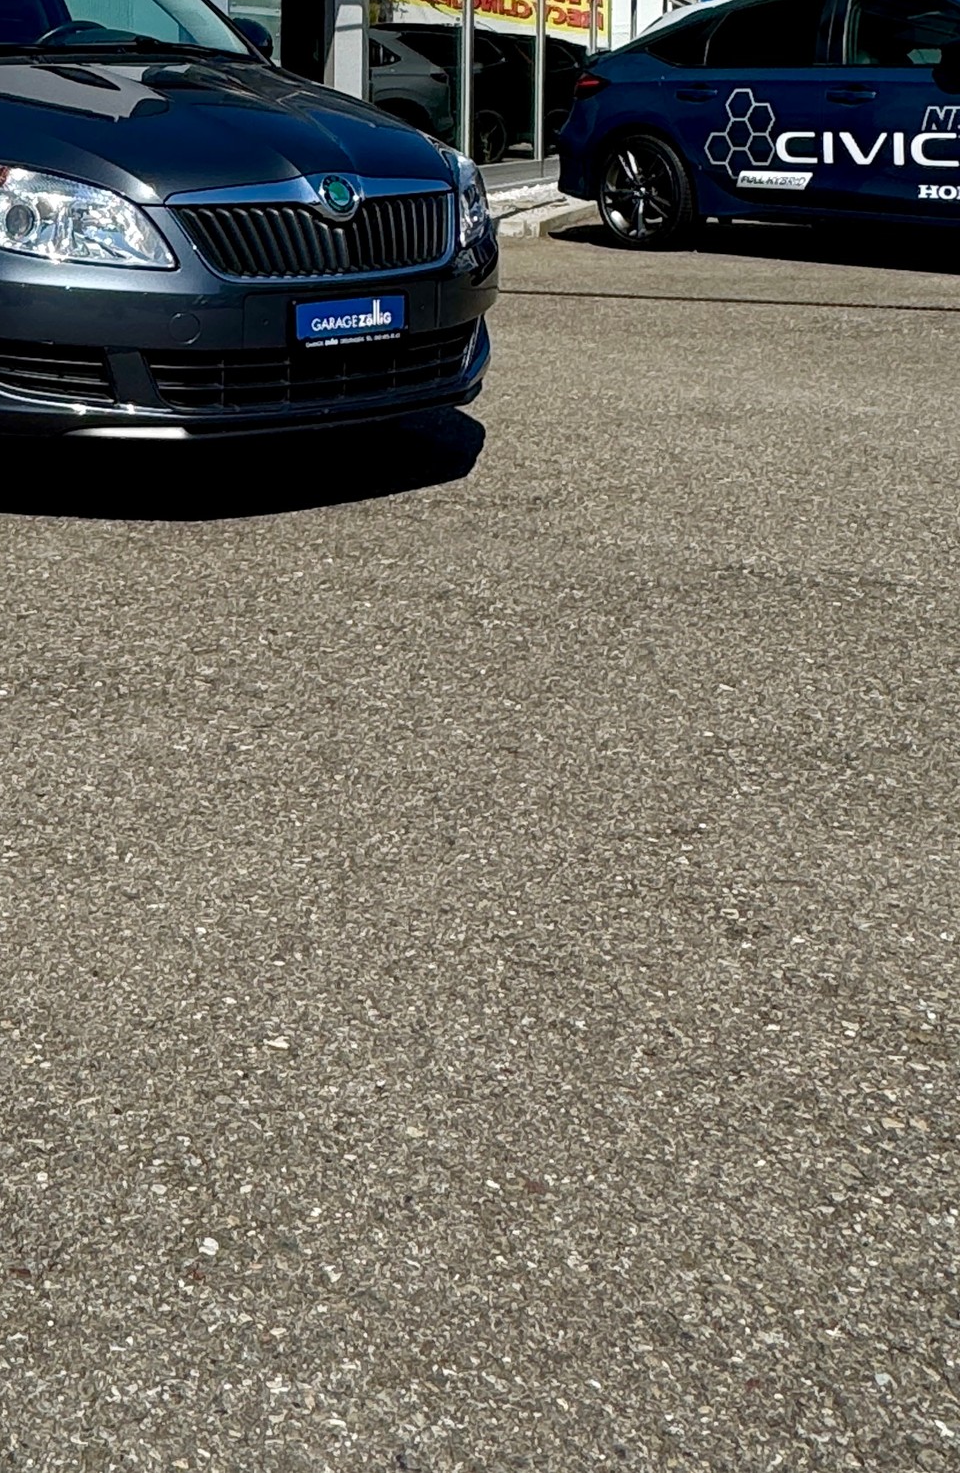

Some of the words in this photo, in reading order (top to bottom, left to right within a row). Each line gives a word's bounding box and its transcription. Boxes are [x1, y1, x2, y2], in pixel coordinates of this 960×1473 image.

[775, 131, 960, 167] CIVIC
[918, 185, 960, 200] HO
[311, 315, 358, 331] GARAGE
